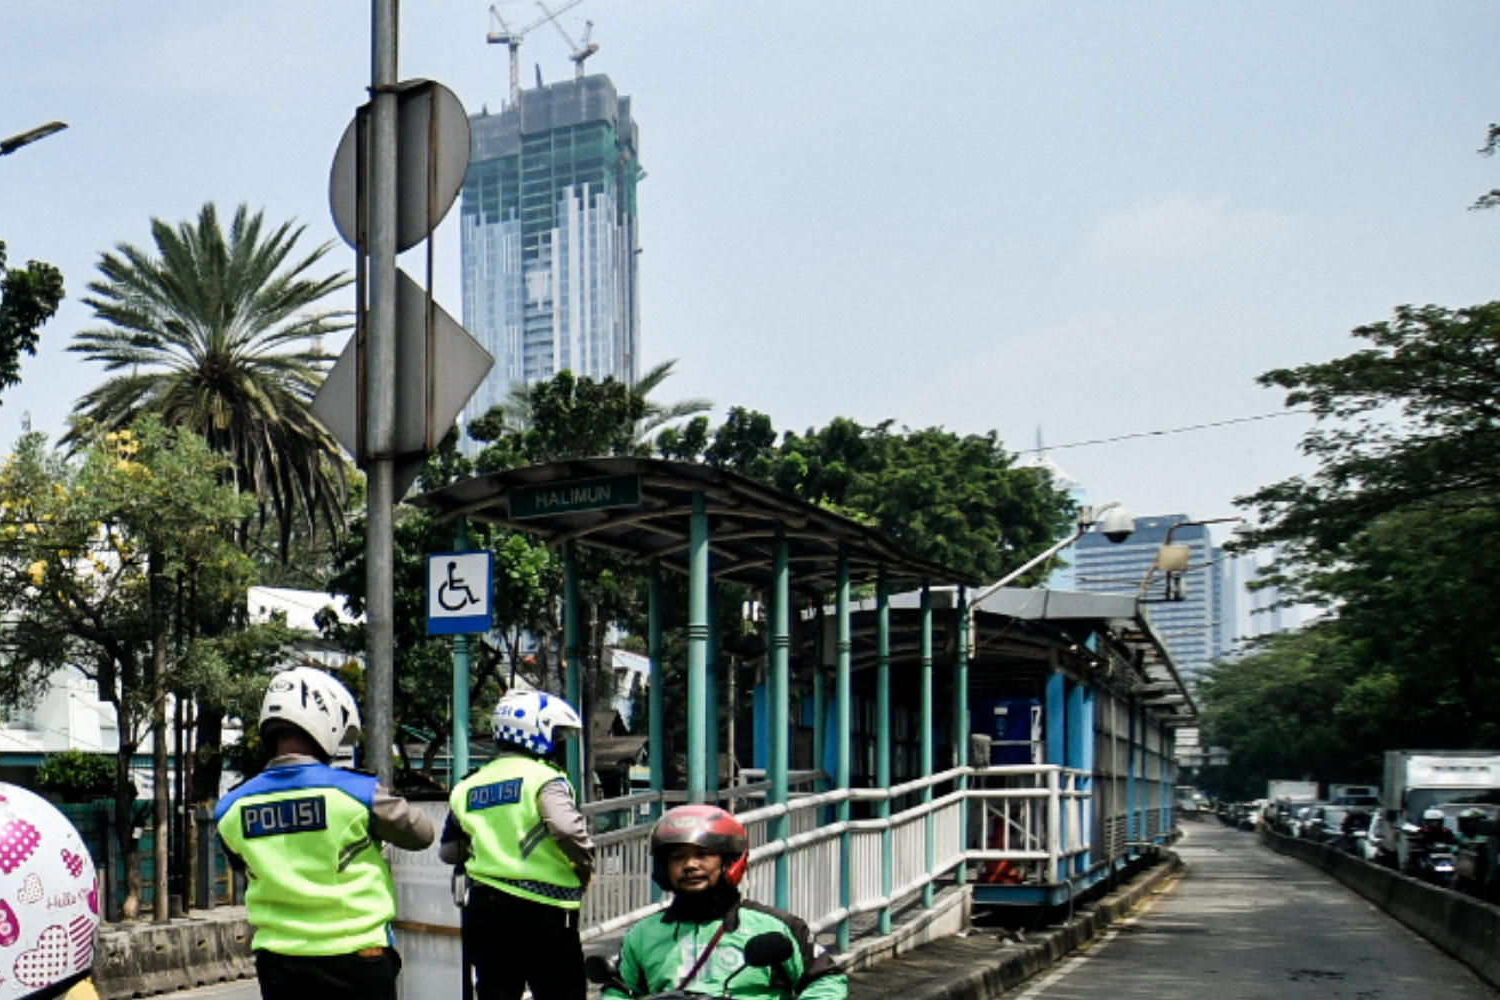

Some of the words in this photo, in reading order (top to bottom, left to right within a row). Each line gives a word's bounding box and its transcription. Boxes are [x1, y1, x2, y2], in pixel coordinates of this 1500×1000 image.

[535, 484, 612, 508] HALIMUN
[469, 783, 520, 804] POLISI
[244, 800, 322, 833] POLISI
